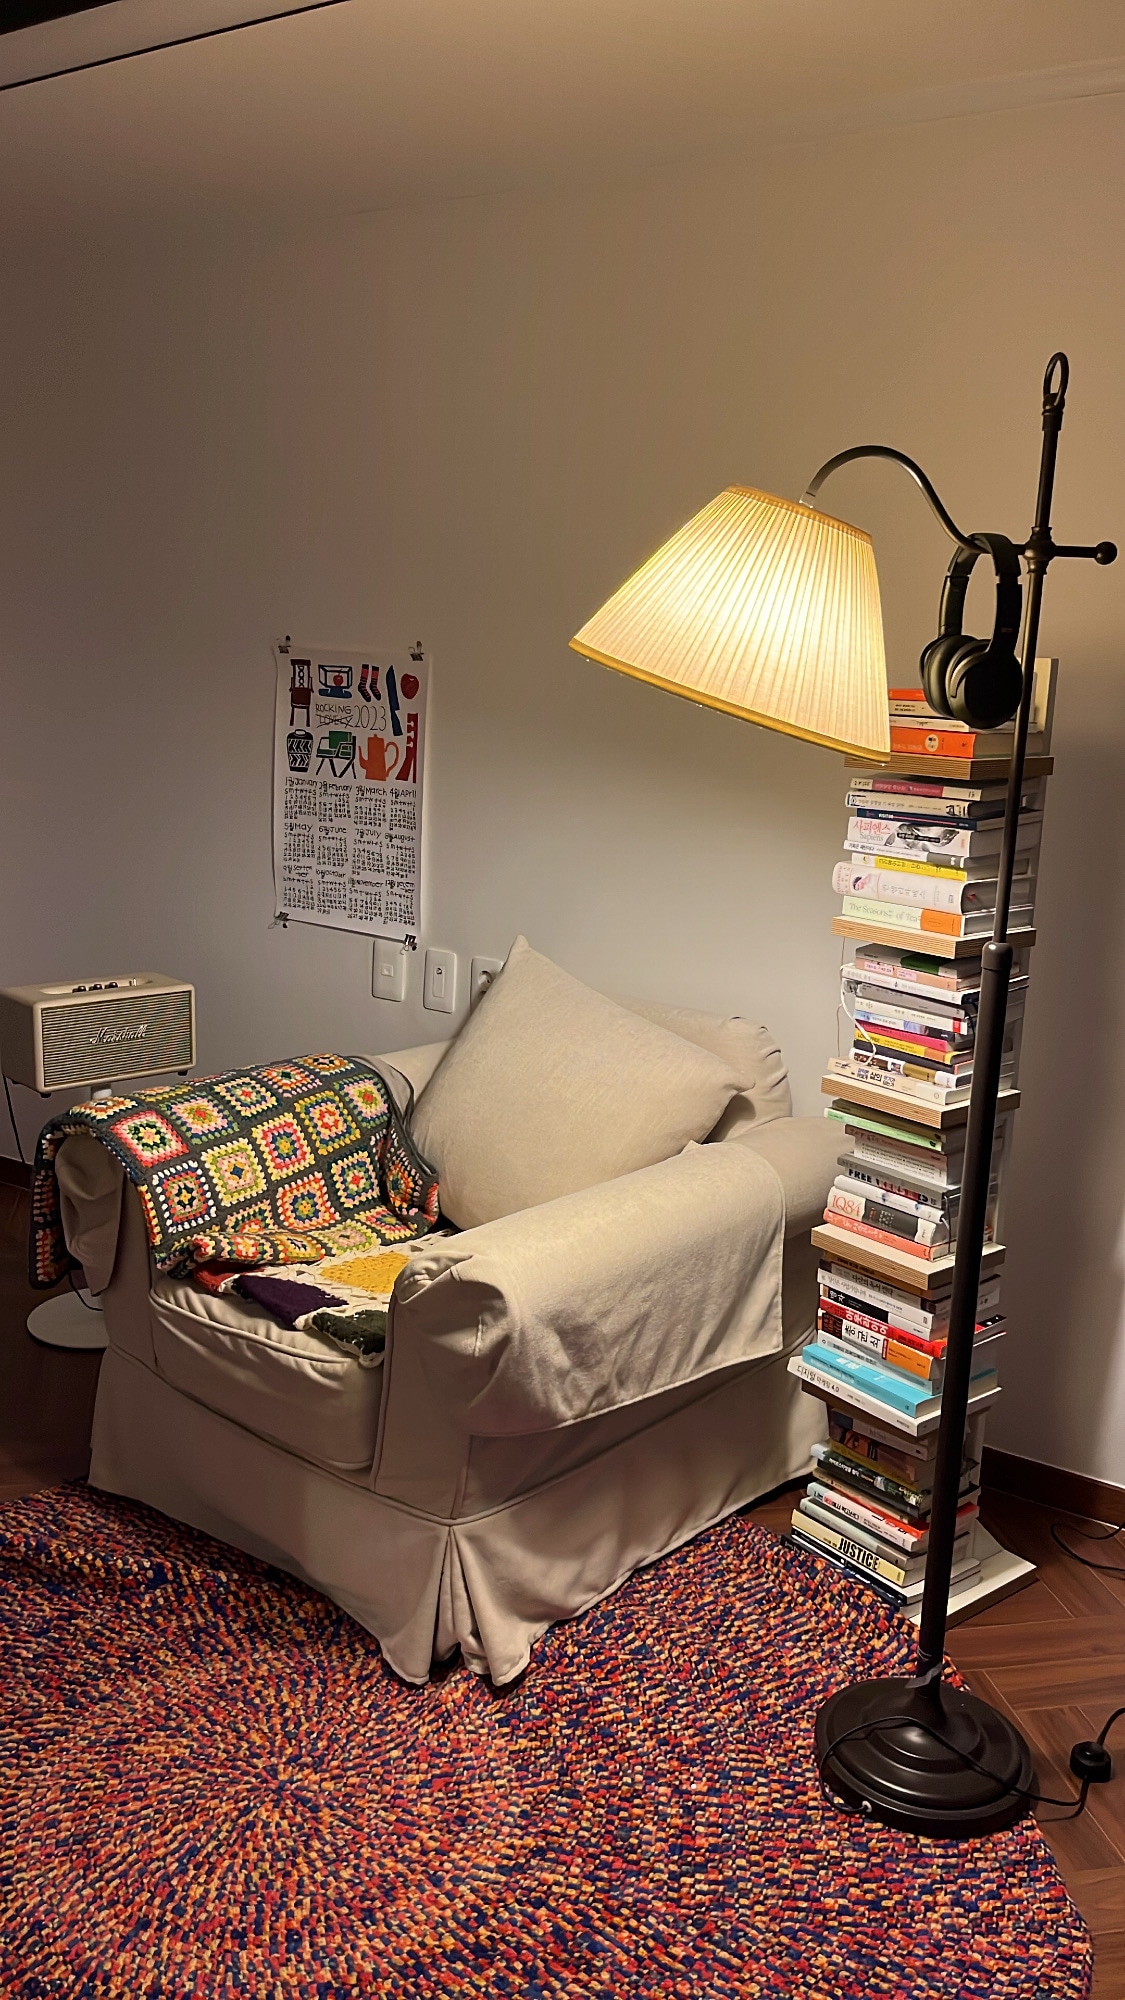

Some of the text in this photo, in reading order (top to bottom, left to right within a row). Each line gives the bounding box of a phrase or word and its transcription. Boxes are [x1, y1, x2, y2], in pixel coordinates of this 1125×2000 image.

[315, 703, 352, 714] ROCKING
[354, 704, 387, 731] 2023
[853, 820, 891, 835] 사피엔스
[859, 832, 884, 842] Sapiens
[849, 902, 862, 911] The
[863, 904, 890, 917] Seasons
[896, 911, 904, 920] of
[89, 1024, 148, 1044] Marshall
[848, 1168, 872, 1183] FREE
[831, 1194, 862, 1217] 1Q84
[845, 1309, 889, 1335] 아웃라이어
[797, 1365, 816, 1381] 디지털
[831, 1384, 840, 1393] 4.0
[838, 1537, 880, 1571] JUSTICE
